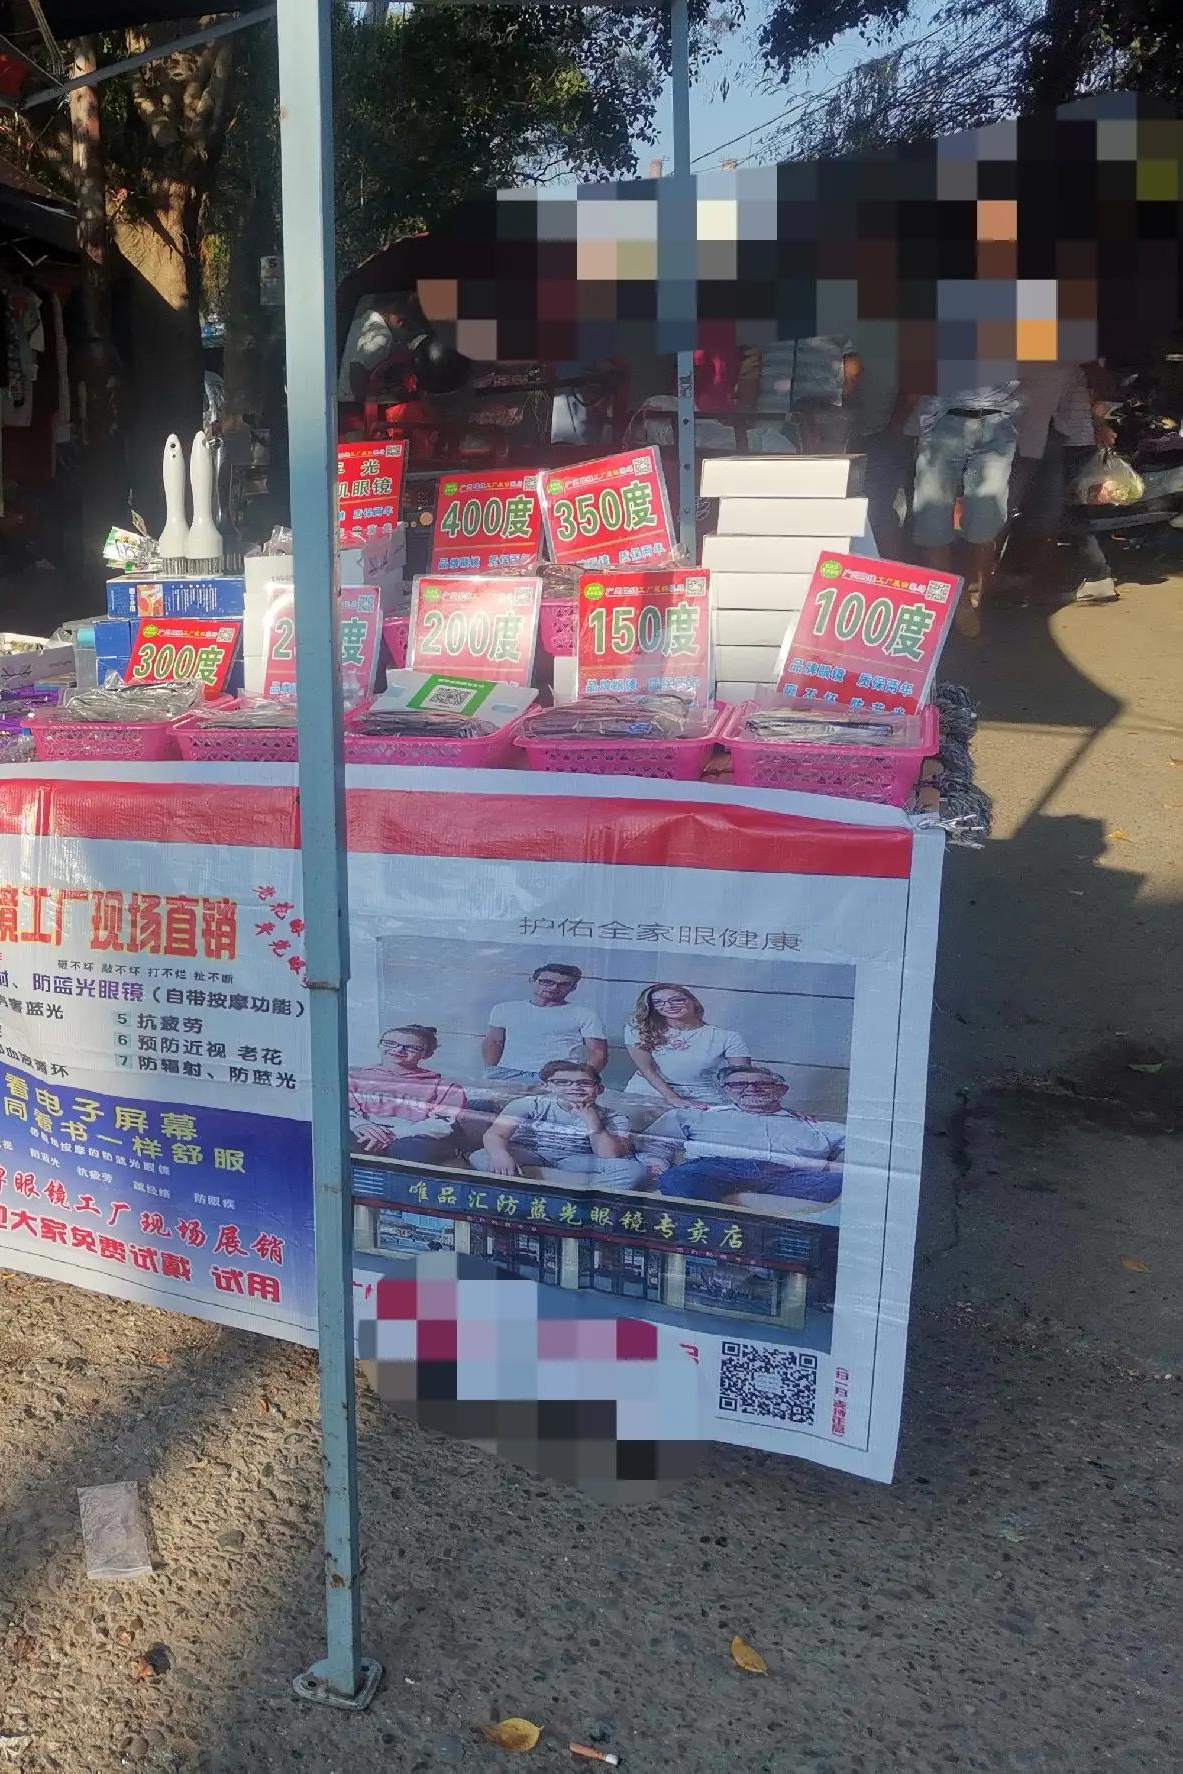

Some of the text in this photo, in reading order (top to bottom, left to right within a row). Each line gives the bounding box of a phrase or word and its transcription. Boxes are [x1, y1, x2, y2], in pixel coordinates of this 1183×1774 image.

[440, 494, 534, 539] 400度
[554, 480, 657, 541] 350度
[420, 610, 524, 662] 200度
[589, 601, 700, 657] 150度
[813, 588, 936, 662] 100度
[133, 643, 224, 686] 300度
[789, 658, 914, 696] 品牌眼镜 质保两年
[519, 916, 804, 953] 护佑全家眼健康
[102, 963, 141, 976] 敲不坏
[148, 968, 186, 980] 打不烂
[194, 971, 233, 984] 扯不断
[117, 1013, 203, 1034] 5 抗疲劳
[118, 1034, 283, 1066] 6 预防近视 老花
[138, 1056, 297, 1090] 防辐射、防蓝光
[4, 1072, 199, 1141] 看电子屏幕
[194, 1192, 236, 1210] 防眼疾
[408, 1180, 746, 1250] 唯品汇防蓝光眼镜专卖店
[211, 1264, 281, 1303] 试用
